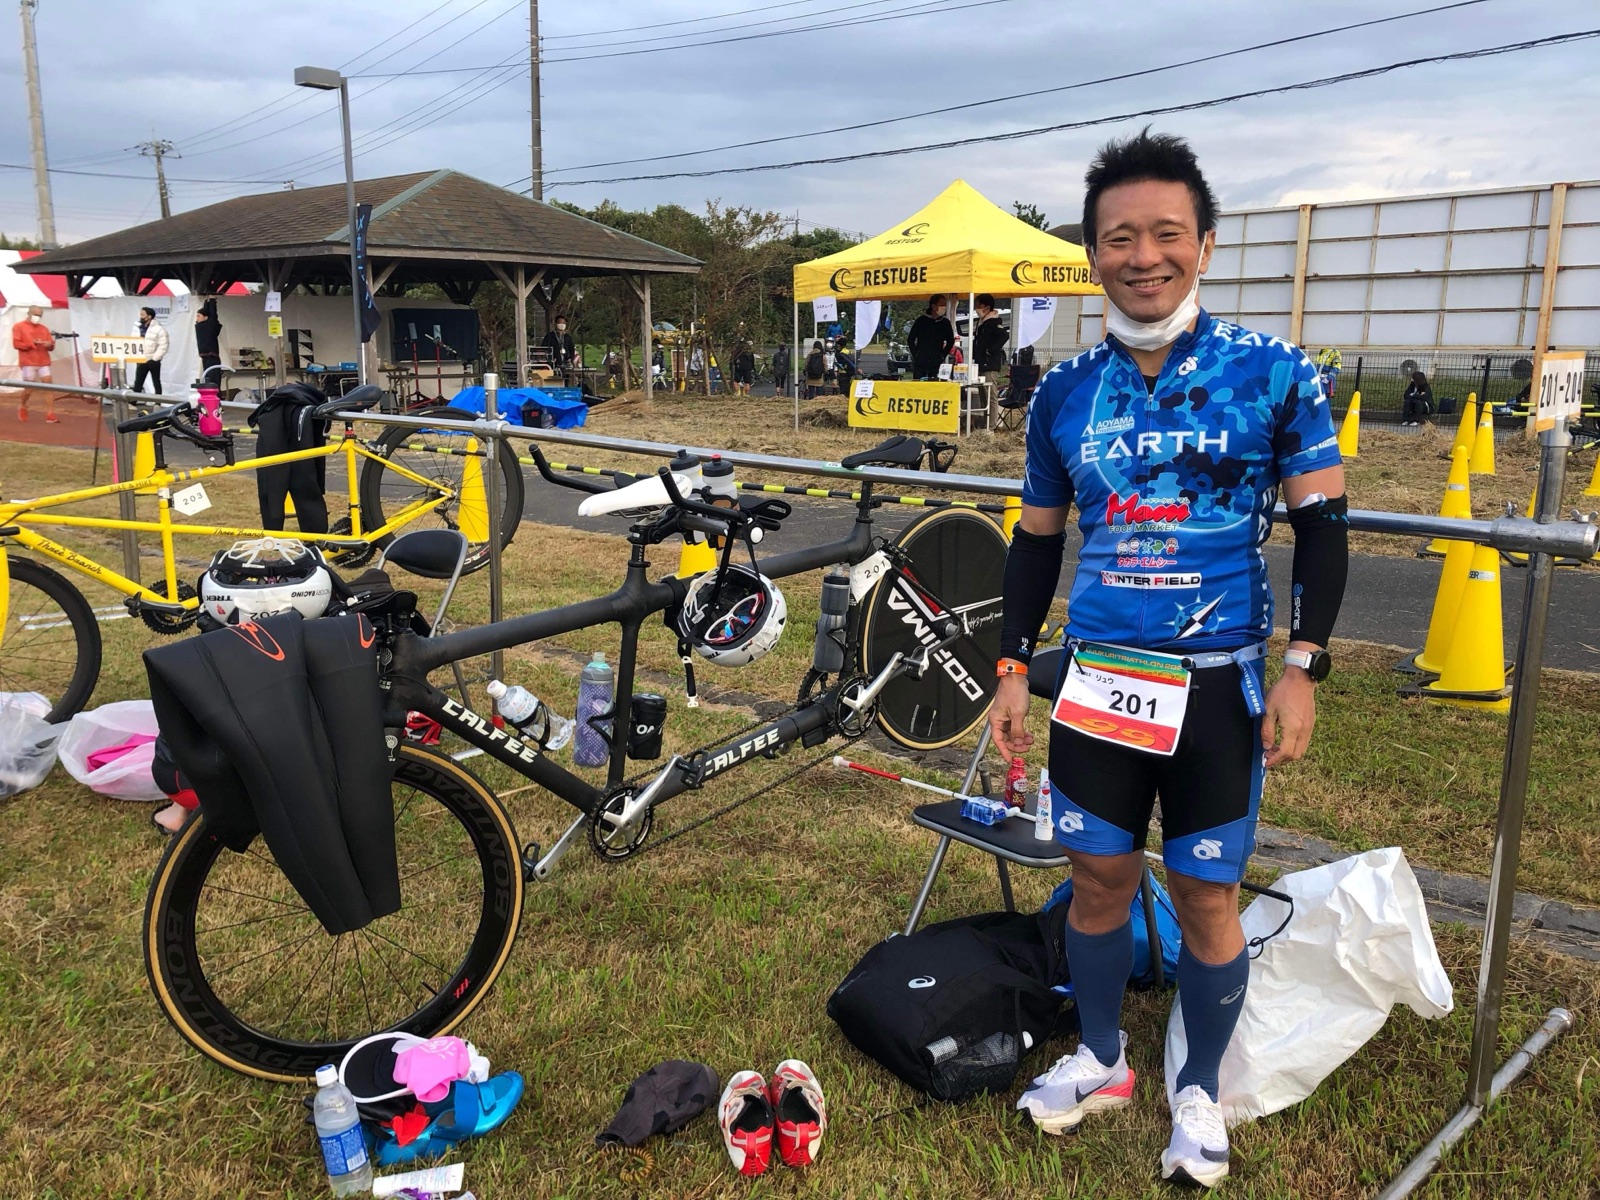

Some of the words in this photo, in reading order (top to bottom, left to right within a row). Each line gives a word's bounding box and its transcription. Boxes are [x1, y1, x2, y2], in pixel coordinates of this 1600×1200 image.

[884, 237, 925, 245] RESTUBE
[863, 266, 928, 286] RESTUBE
[1043, 265, 1093, 284] RESTUB
[93, 341, 144, 355] 201-204
[1540, 371, 1583, 409] 201-204
[887, 397, 950, 416] RESTUBE
[1096, 415, 1134, 429] AOYAMA
[1080, 429, 1230, 464] EARTH
[109, 484, 126, 492] BIKE
[182, 492, 203, 506] 203
[1108, 525, 1133, 534] FOOD
[1134, 523, 1179, 533] MARKET
[37, 539, 65, 557] Three
[67, 552, 102, 575] Branch
[864, 560, 886, 579] 201
[1113, 574, 1151, 586] INTER
[1154, 576, 1200, 586] FIELD
[1096, 674, 1115, 685] リュウ
[1108, 689, 1158, 719] 201
[1249, 689, 1262, 714] WORLD
[441, 697, 538, 764] CALFEE
[400, 761, 511, 919] BONTRAG
